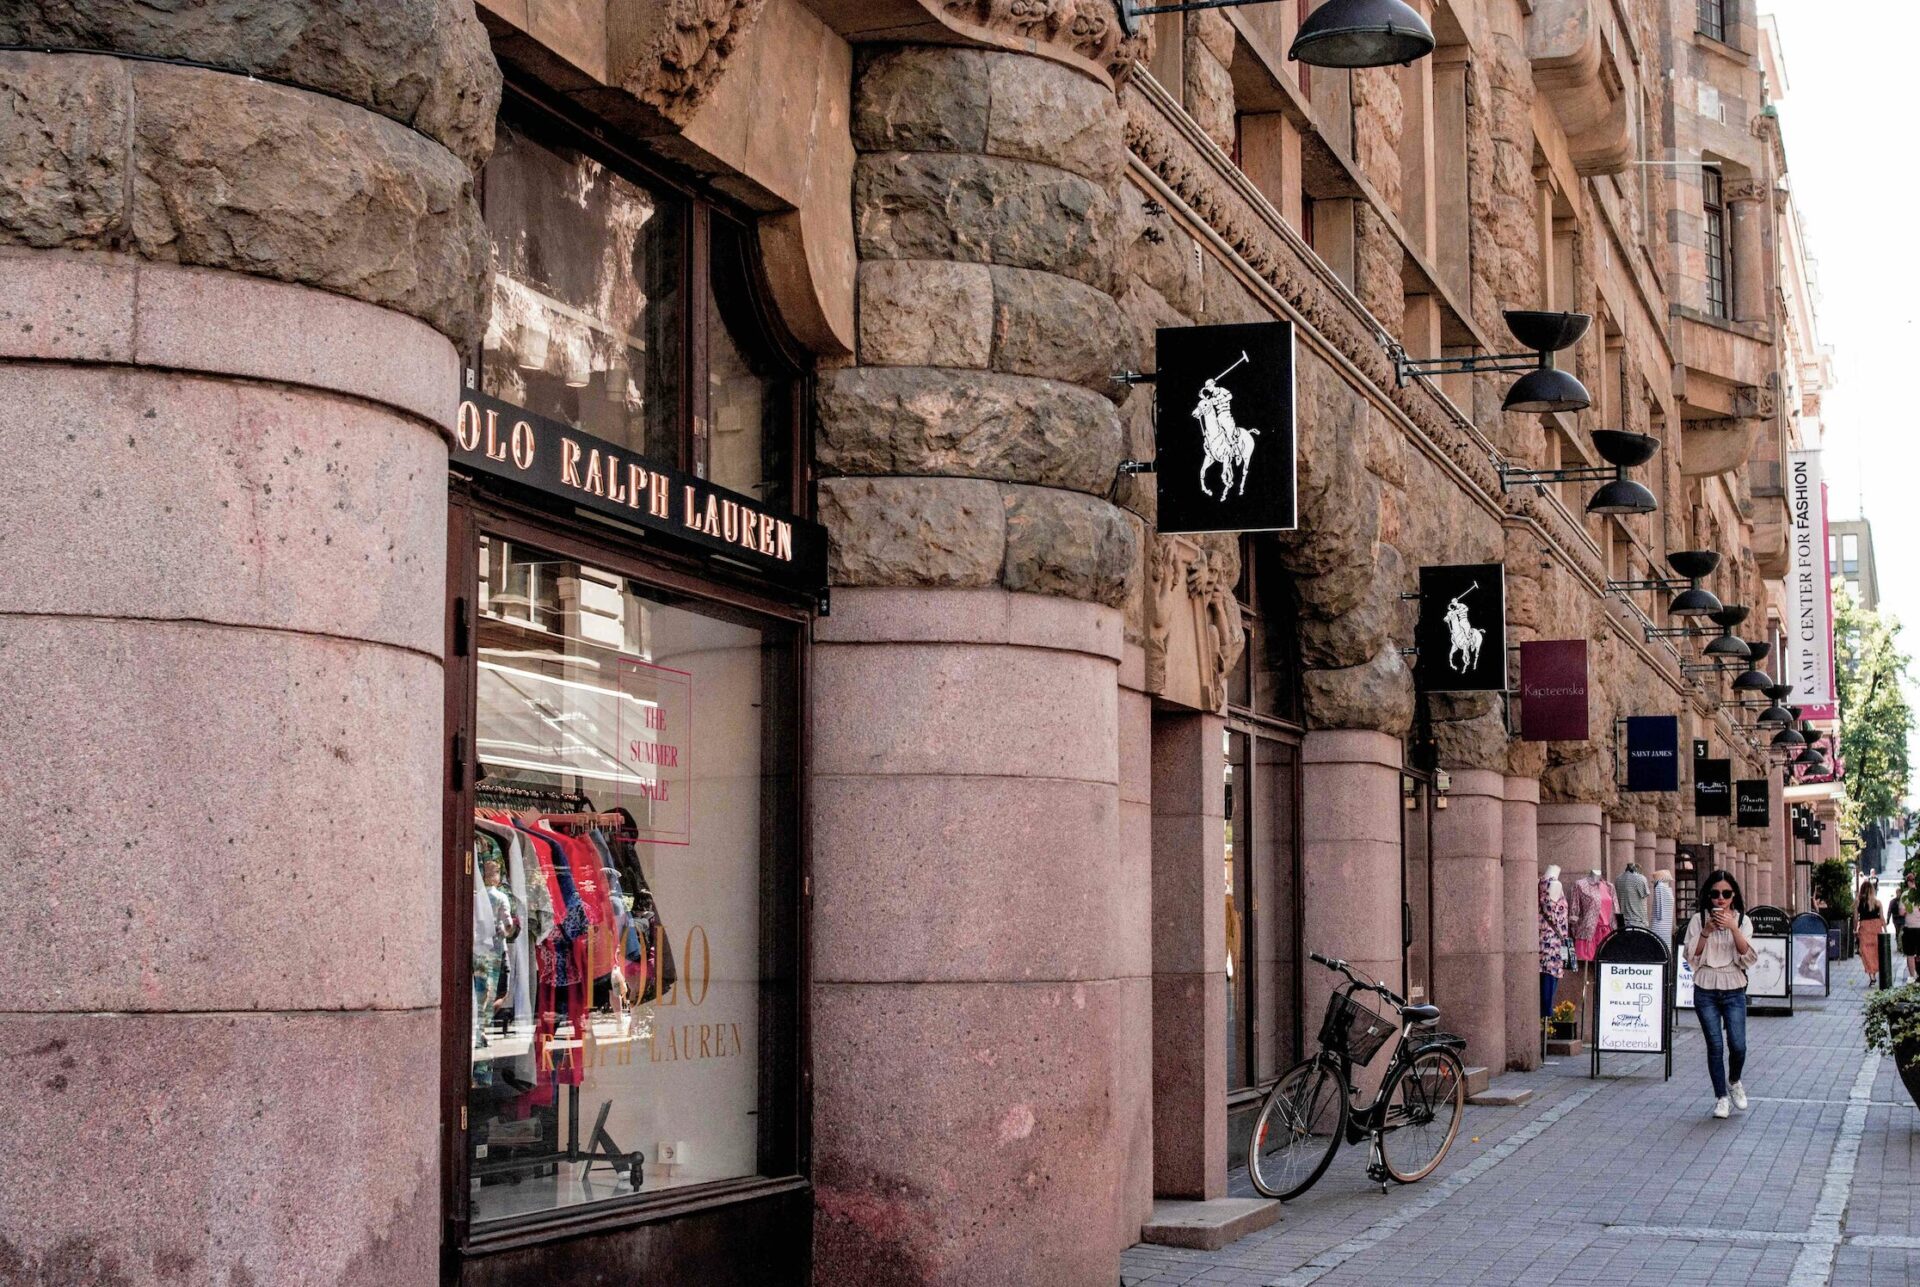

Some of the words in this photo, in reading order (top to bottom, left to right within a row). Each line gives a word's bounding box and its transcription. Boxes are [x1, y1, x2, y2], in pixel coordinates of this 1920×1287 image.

[560, 437, 670, 520] RALPH
[684, 485, 793, 562] LAUREN
[1794, 461, 1810, 530] FASHION
[1797, 534, 1812, 568] FOR
[1798, 572, 1815, 642] CENTER
[1524, 683, 1584, 698] Kapteenska
[644, 706, 667, 731] THE
[630, 740, 678, 768] SUMMER
[1697, 744, 1705, 757] 3
[640, 778, 669, 801] SALE
[586, 924, 710, 1009] POLO
[1610, 966, 1653, 976] Barbour
[1625, 982, 1653, 990] AIGLE
[651, 1022, 742, 1063] LAUREN
[1602, 1036, 1658, 1049] Kapteenska
